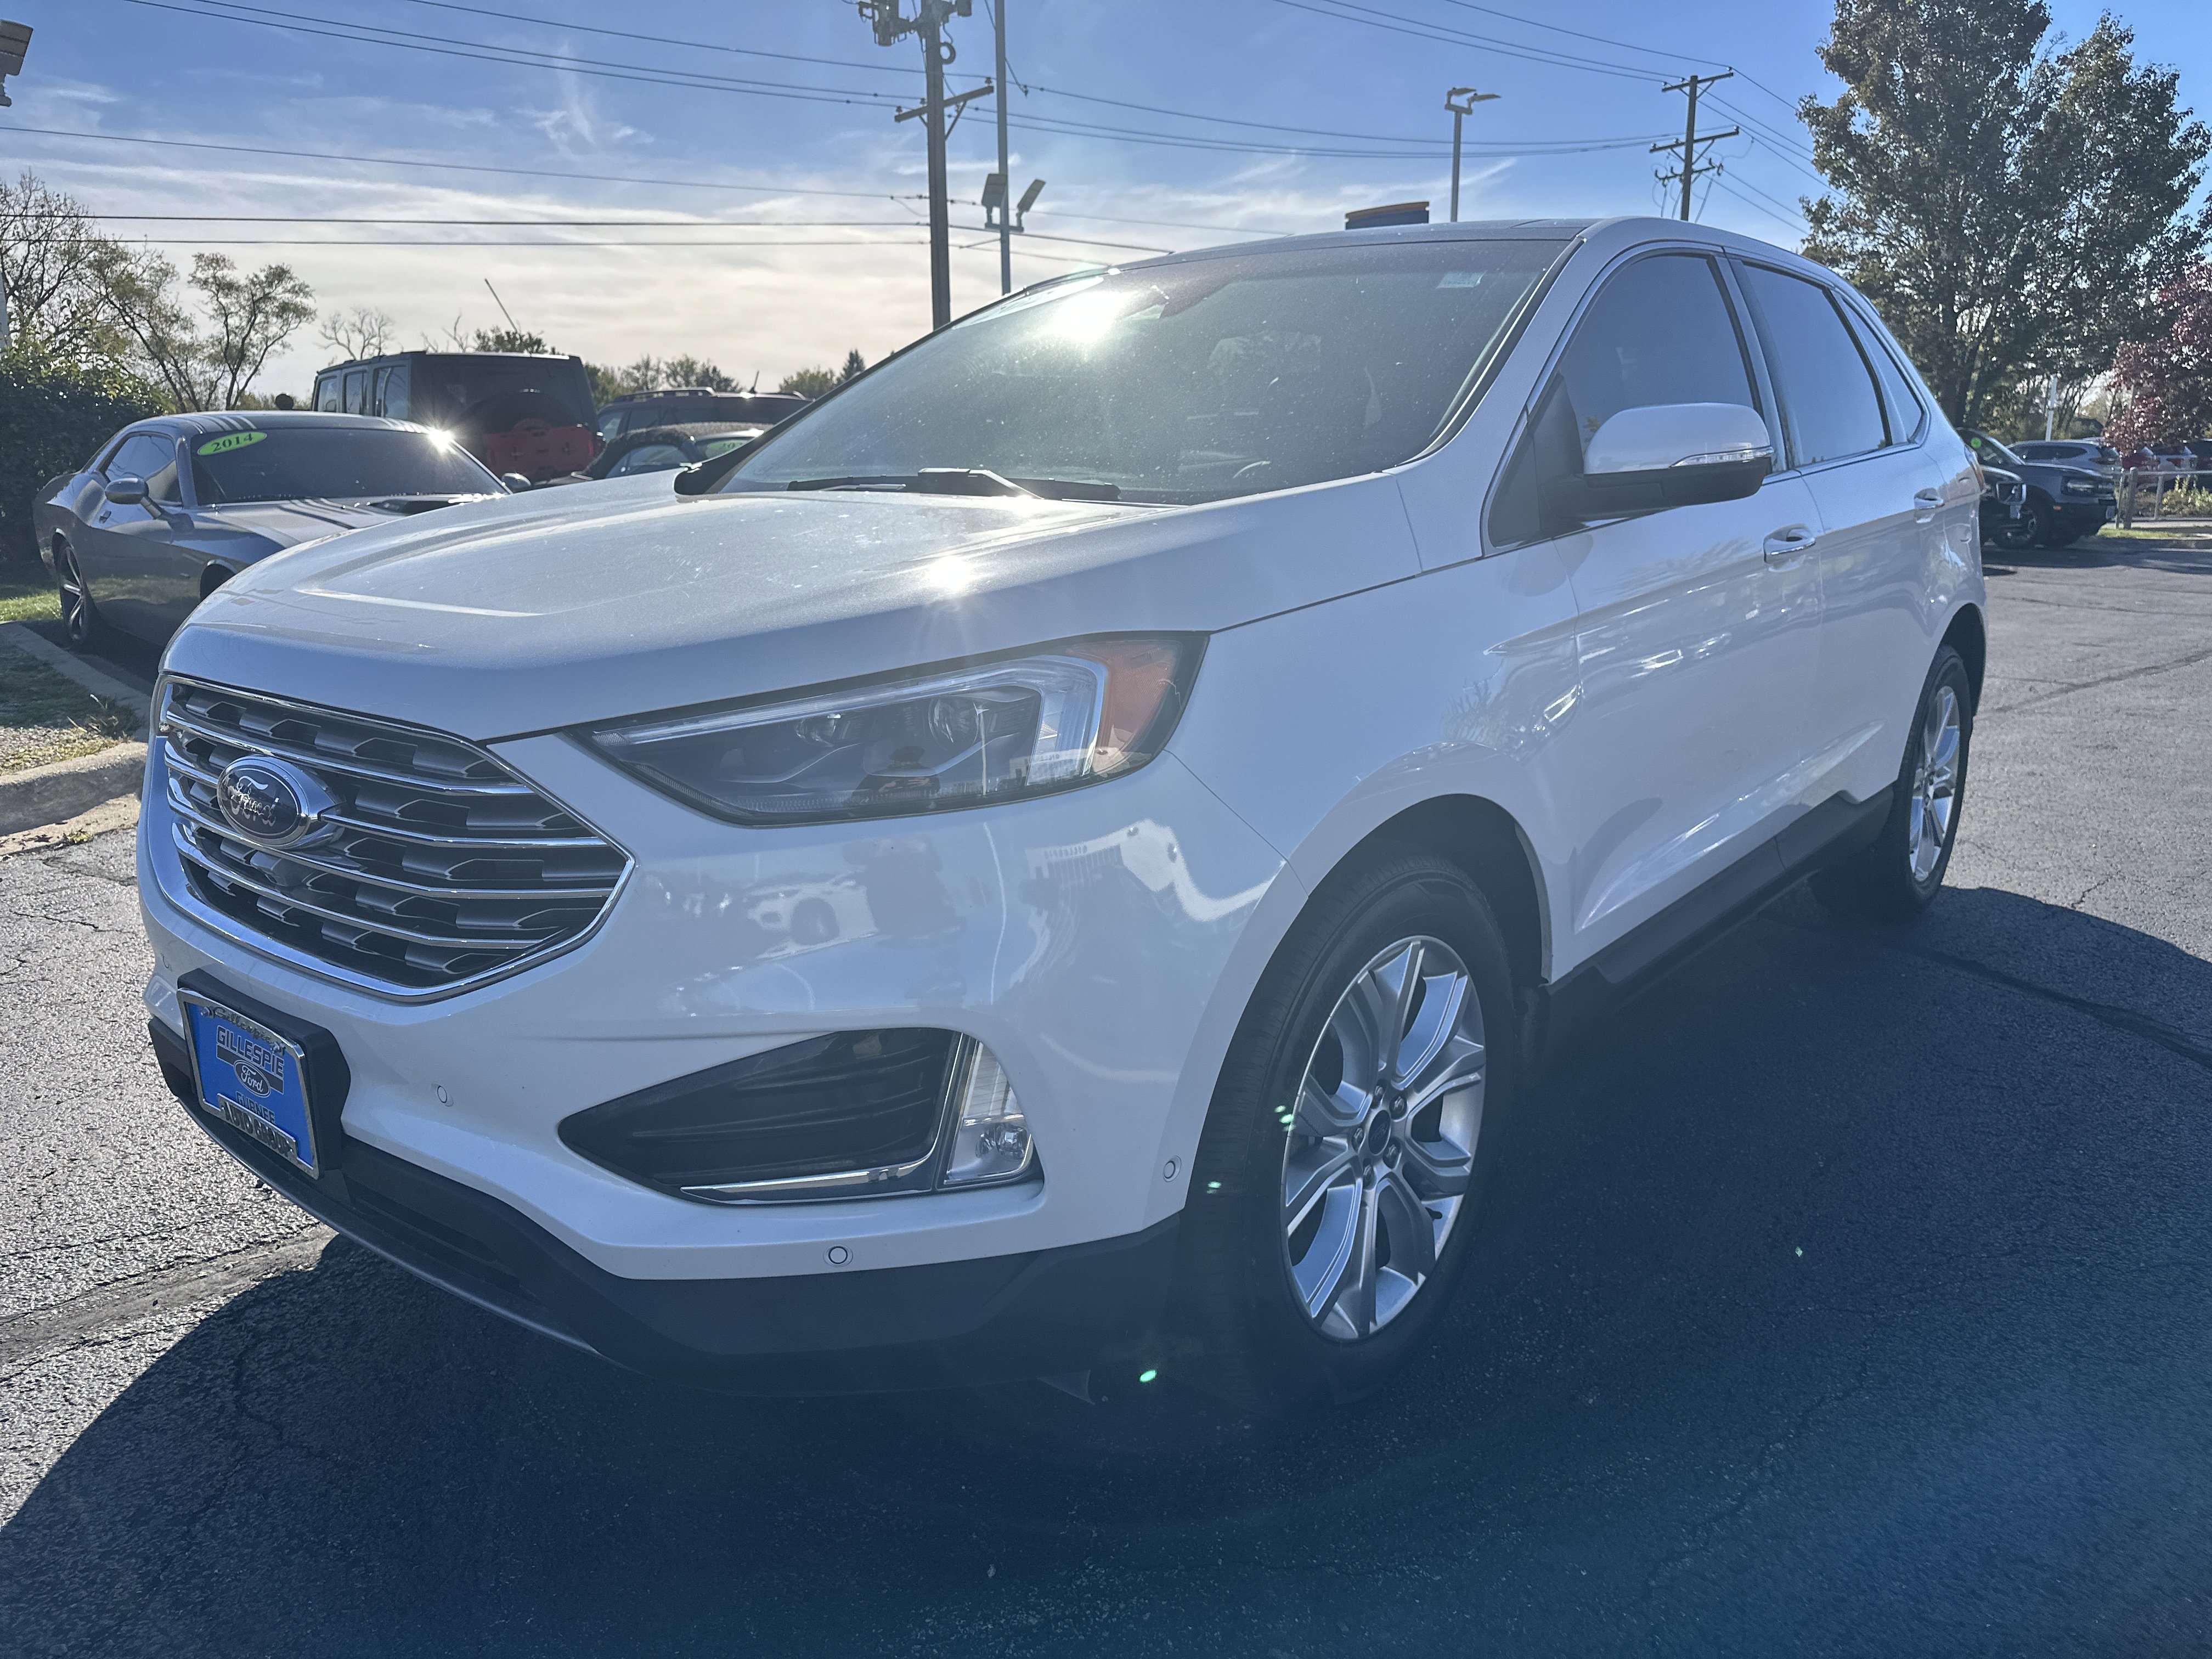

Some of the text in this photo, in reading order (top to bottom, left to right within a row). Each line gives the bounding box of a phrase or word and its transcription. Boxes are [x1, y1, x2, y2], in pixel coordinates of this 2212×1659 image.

[211, 433, 253, 452] 2014
[217, 1025, 284, 1079] GILLESPIE
[241, 1065, 264, 1092] Ford
